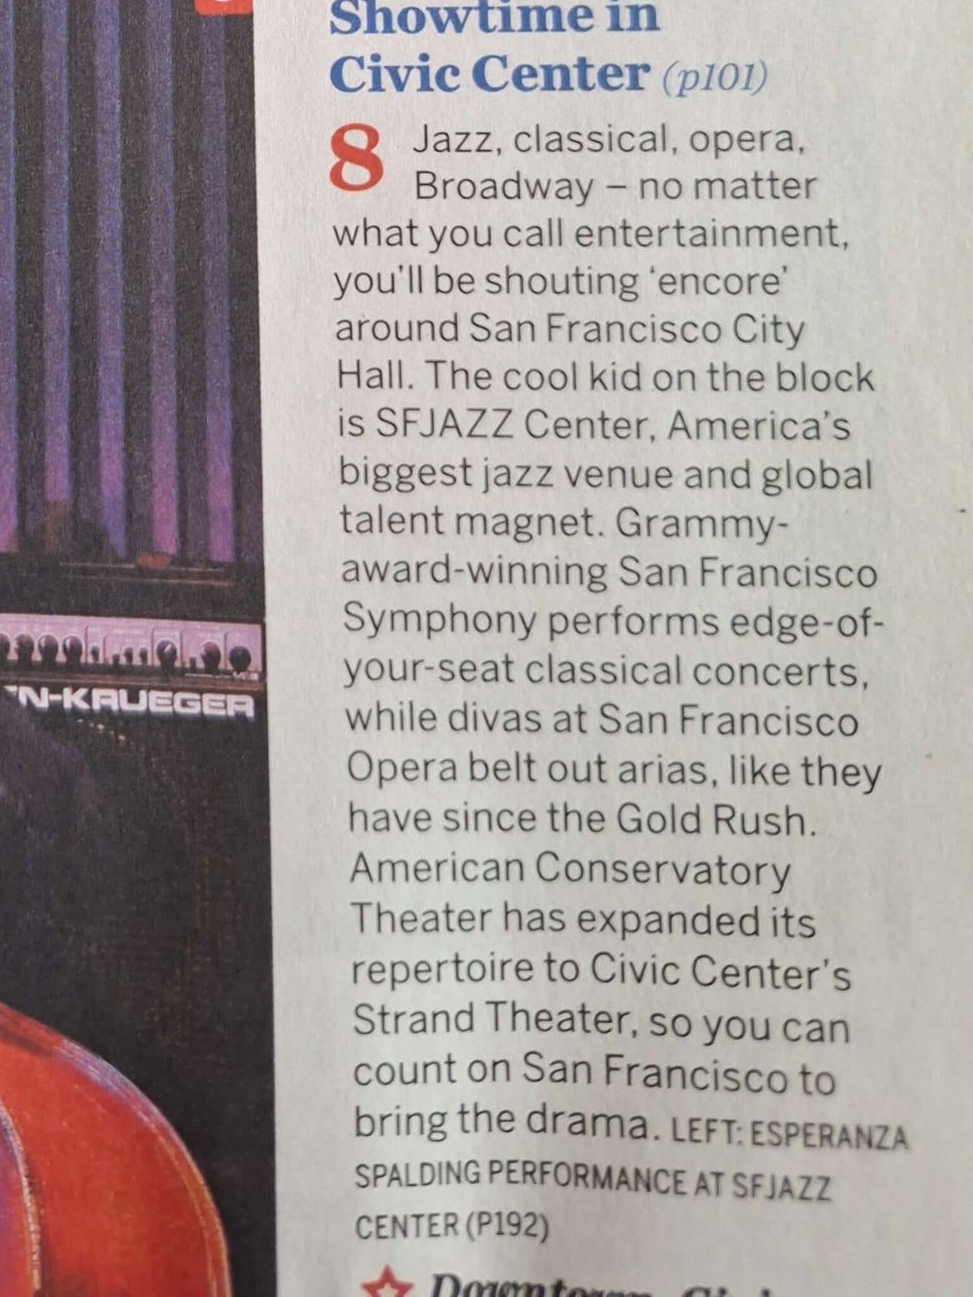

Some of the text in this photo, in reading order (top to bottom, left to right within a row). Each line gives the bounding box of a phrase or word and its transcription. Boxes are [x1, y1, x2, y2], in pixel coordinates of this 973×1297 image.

[330, 52, 767, 98] Civic Center (p101)
[329, 122, 384, 192] 8
[413, 123, 804, 159] Jazz, classical, opera,
[415, 170, 818, 207] Broadway no matter
[332, 217, 849, 254] what you call entertainment,
[333, 264, 787, 303] you'll be shouting 'encore'
[336, 312, 805, 351] around San Francisco City
[338, 359, 875, 393] Hall. The cool kid on the block
[339, 406, 851, 443] is SFJAZZ Center, America's
[340, 455, 873, 497] biggest jazz venue and global
[339, 504, 789, 546] talent magnet. Grammy-
[342, 553, 878, 594] award-winning San Francisco
[344, 600, 884, 645] Symphony performs edge-of-
[343, 652, 868, 691] your-seat classical concerts,
[345, 700, 859, 737] while divas at San Francisco
[347, 749, 883, 795] Opera belt out arias, like they
[349, 800, 816, 836] have since the Gold Rush.
[349, 850, 791, 894] American Conservatory
[350, 900, 816, 941] Theater has expanded its
[353, 951, 852, 992] repertoire to Civic Center's
[354, 1000, 850, 1047] Strand Theater, so you can
[353, 1050, 837, 1096] count on San Francisco to
[355, 1102, 910, 1152] bring the drama. LEFT: ESPERANZA
[355, 1159, 833, 1203] SPALDING PERFORMANCE AT SFJAZZ
[355, 1211, 549, 1244] CENTER (P192)
